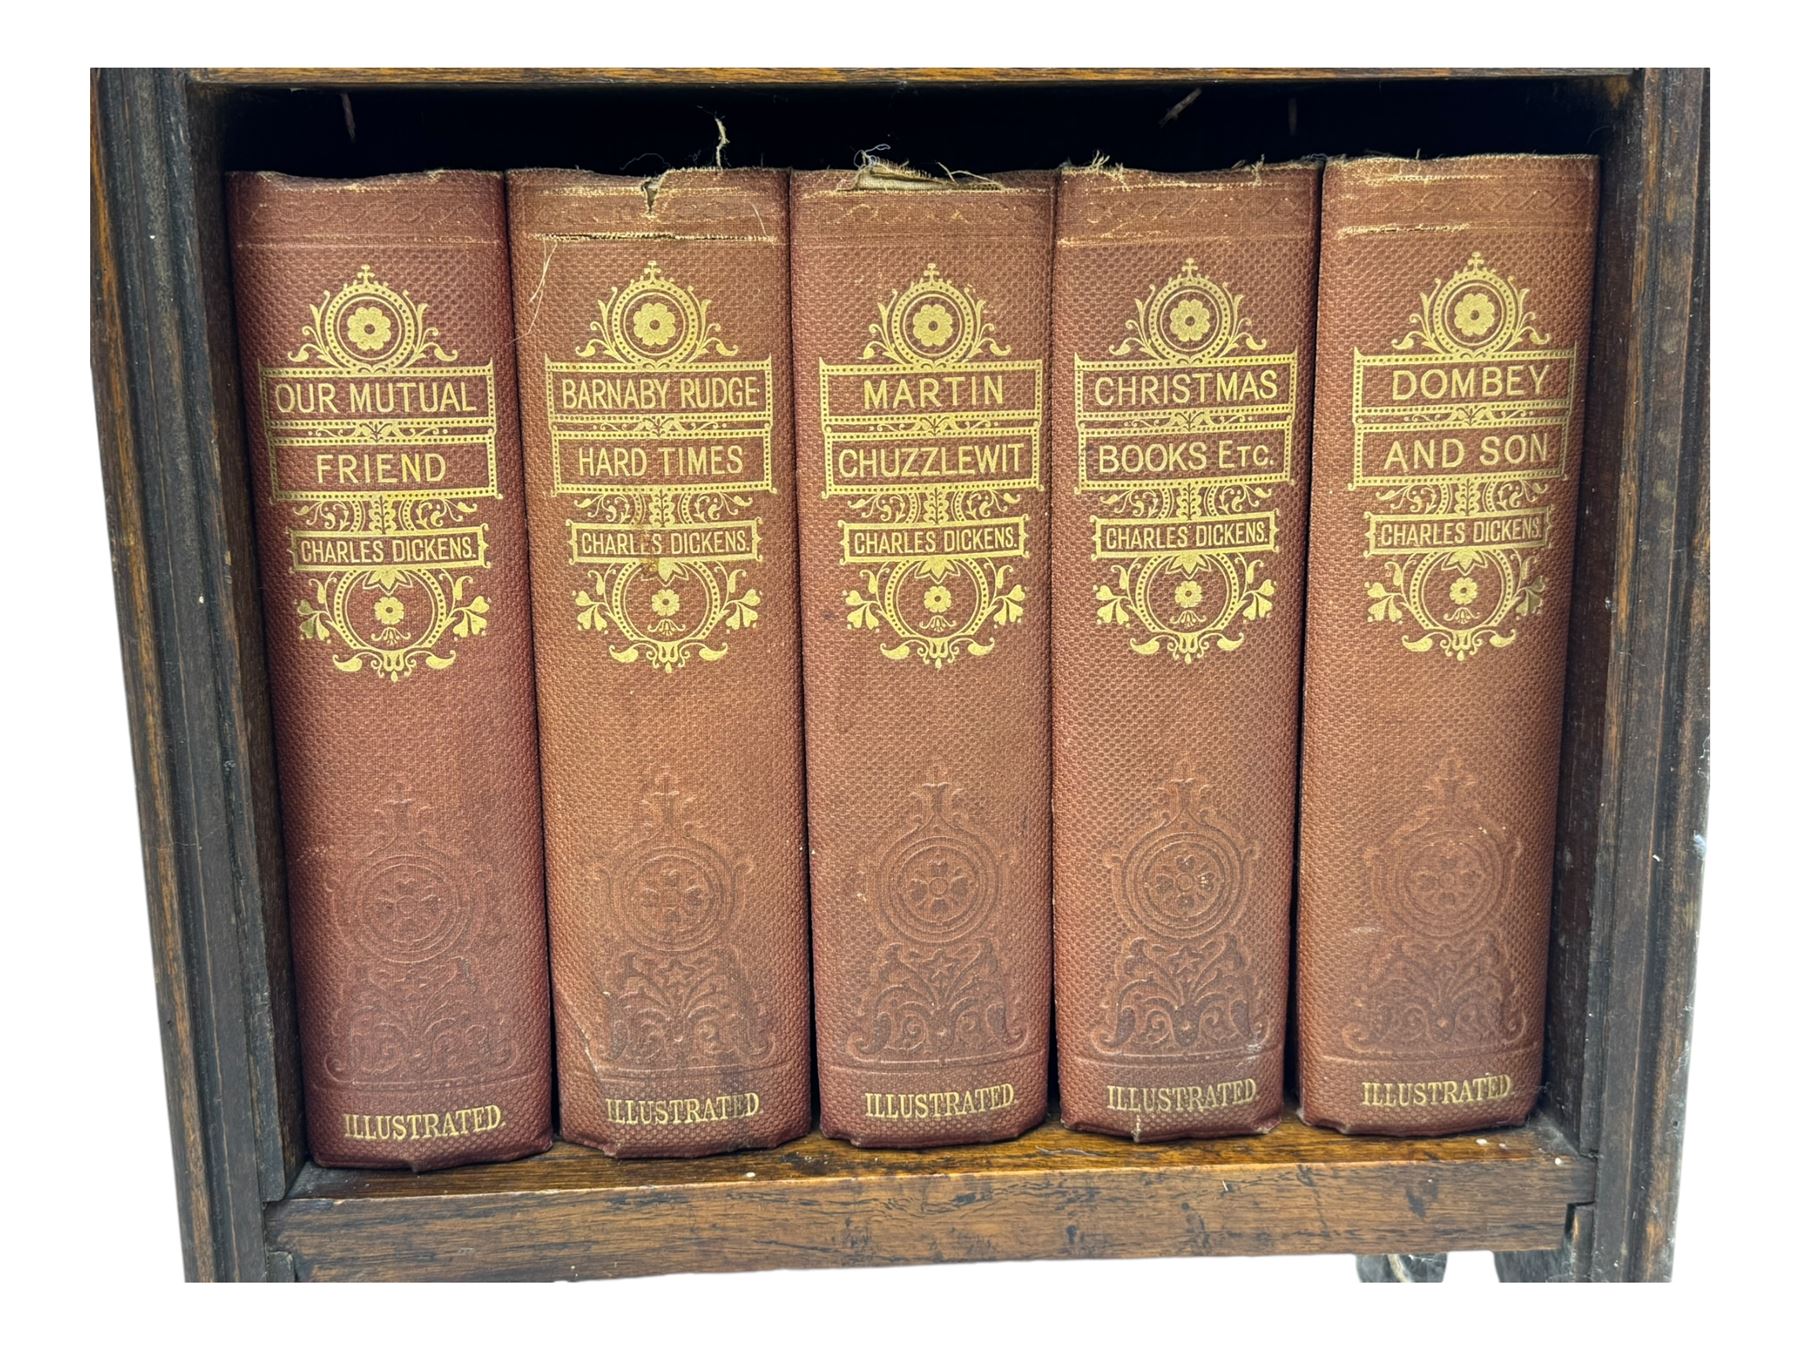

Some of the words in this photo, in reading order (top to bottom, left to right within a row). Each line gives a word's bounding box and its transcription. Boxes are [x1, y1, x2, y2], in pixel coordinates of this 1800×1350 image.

[274, 382, 338, 414] OUR
[349, 381, 478, 414] MUTUAL
[562, 378, 671, 410] BARNABY
[680, 376, 759, 408] RUDGE
[863, 375, 1005, 410] MARTIN
[1094, 370, 1279, 406] CHRISTMAS
[1391, 364, 1550, 401] DOMBEY
[315, 453, 447, 484] FRIEND
[578, 447, 648, 477] HARD
[658, 445, 744, 476] TIMES
[838, 443, 1025, 478] CHUZZLEWIT
[1099, 442, 1207, 473] BOOKS
[1383, 438, 1466, 472] AND
[1479, 433, 1549, 466] SON
[581, 532, 663, 555] CHARLES
[670, 530, 750, 554] DICKENS.
[854, 531, 937, 555] CHARLES
[943, 526, 1018, 552] DICKENS.
[1105, 526, 1189, 550] CHARLES
[1195, 521, 1269, 547] DICKENS.
[1380, 521, 1466, 547] CHARLES
[1473, 516, 1542, 543] DICKENS.
[300, 540, 385, 564] CHARLES
[391, 536, 477, 562] DICKENS.
